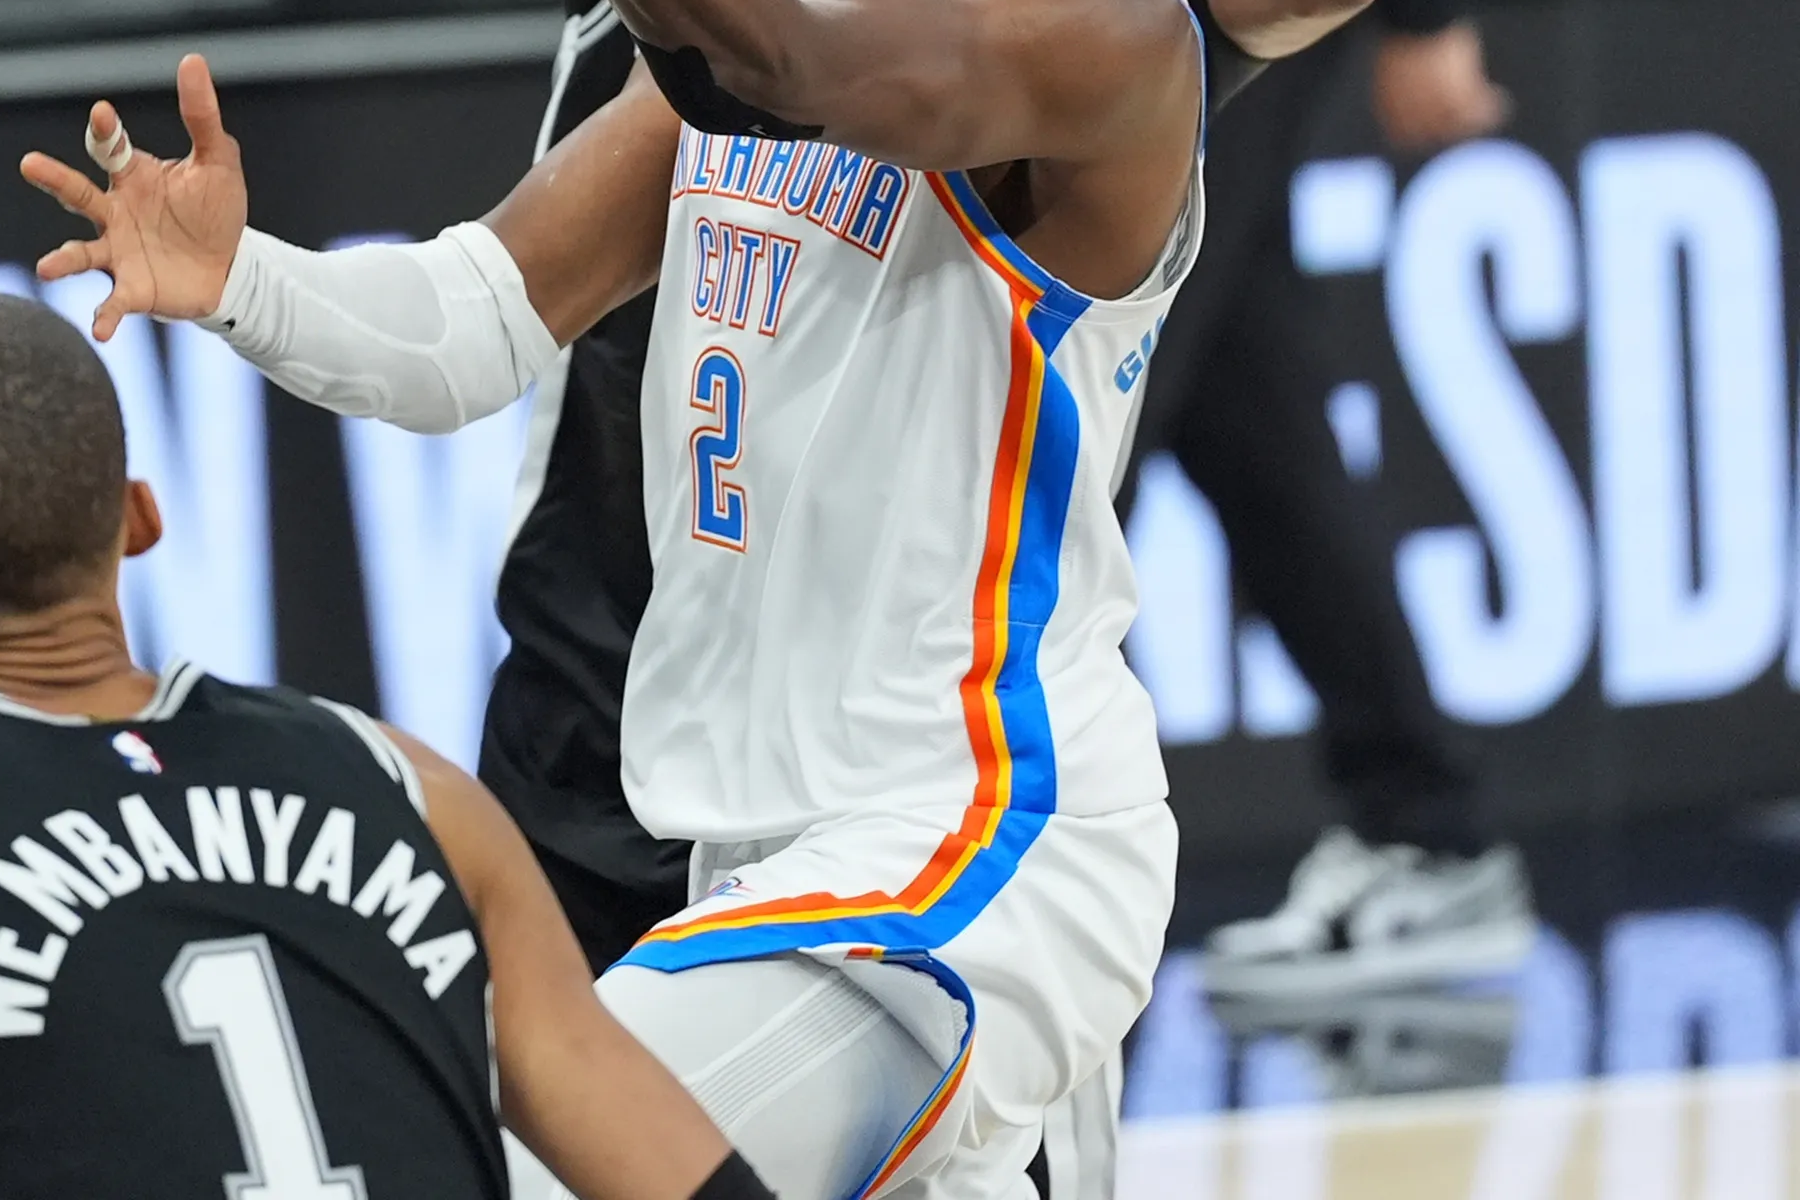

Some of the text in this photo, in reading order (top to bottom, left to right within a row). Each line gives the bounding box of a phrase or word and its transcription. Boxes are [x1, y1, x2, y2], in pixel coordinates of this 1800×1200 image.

[691, 216, 801, 338] CITY
[689, 345, 748, 555] 2
[162, 933, 370, 1200] 1
